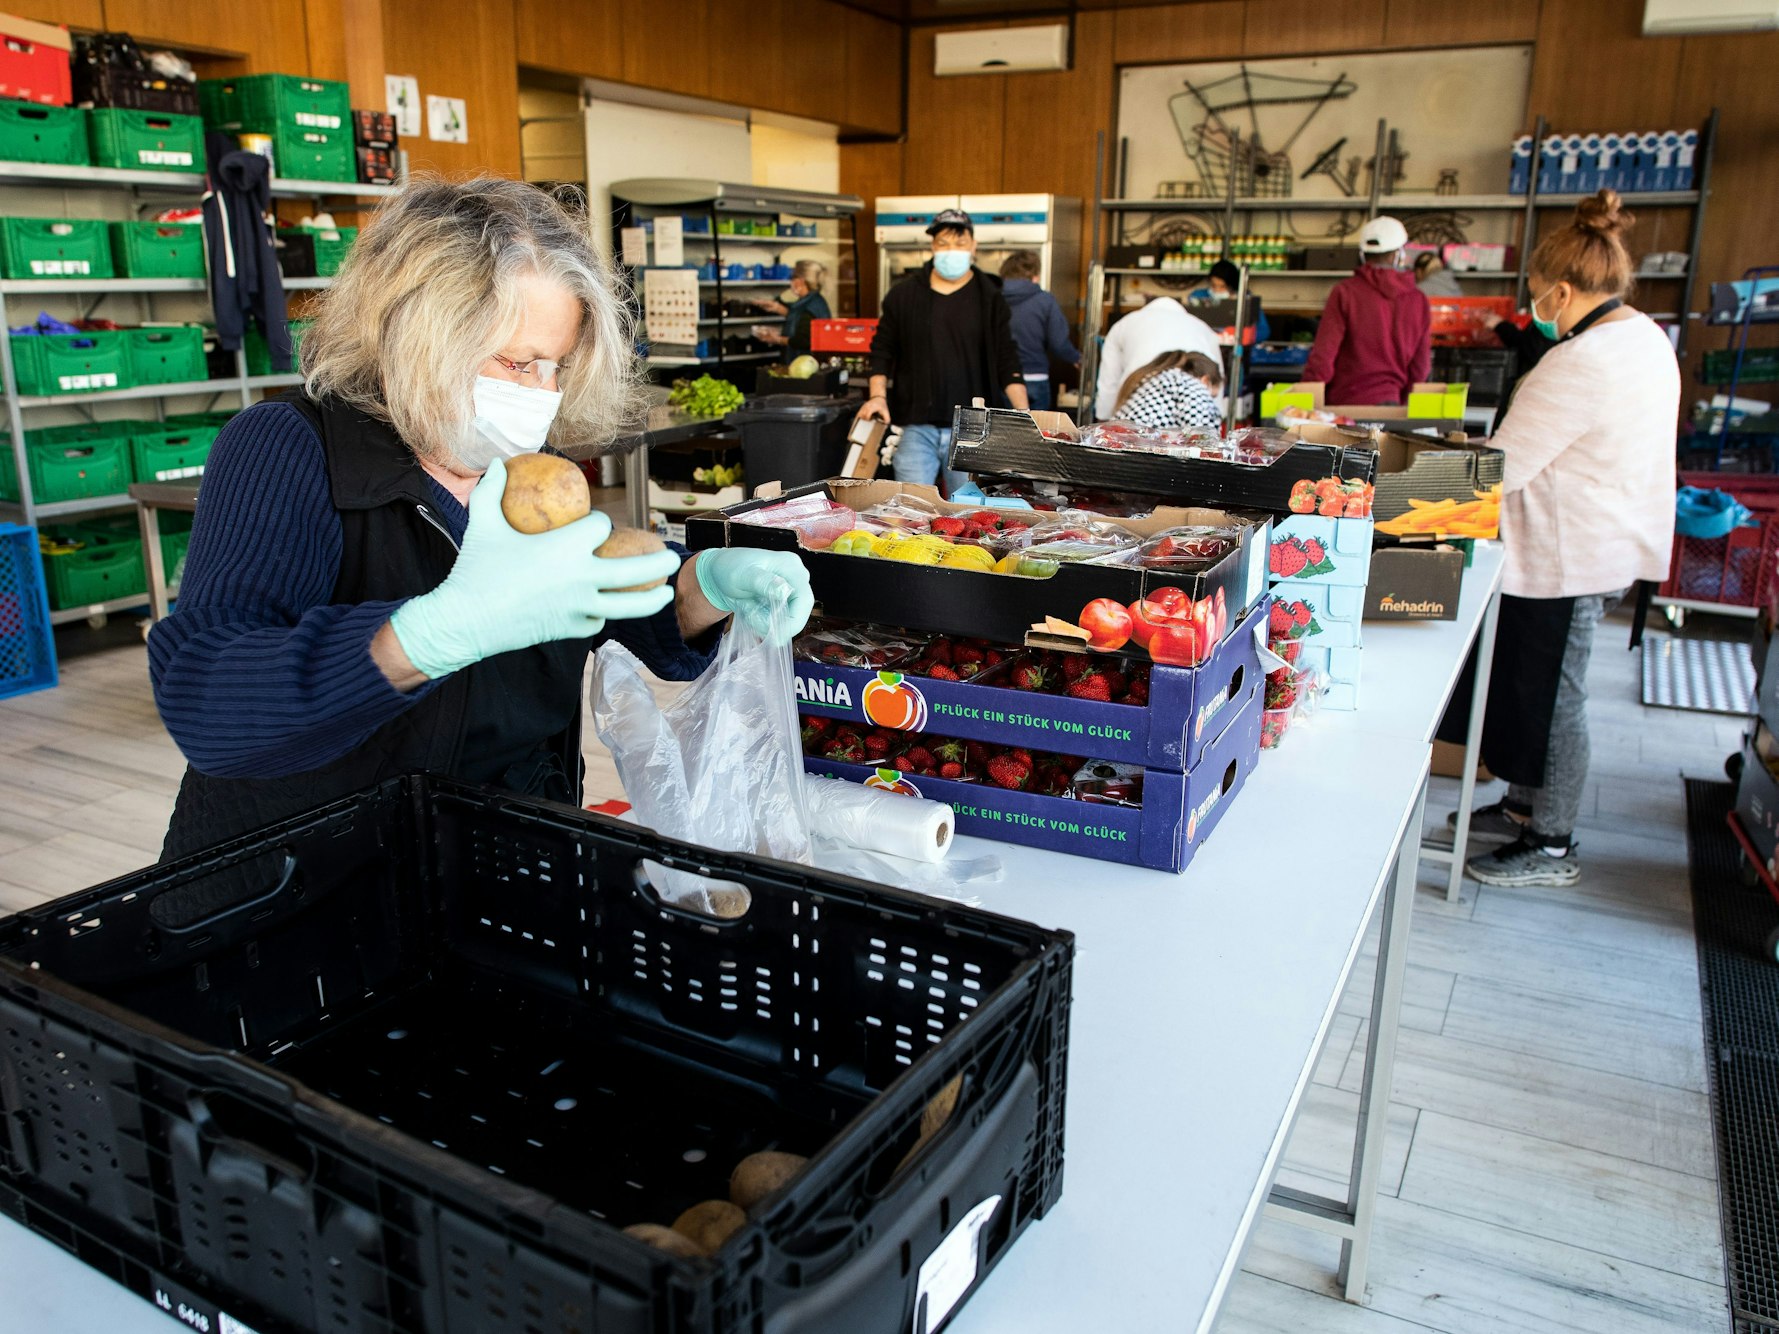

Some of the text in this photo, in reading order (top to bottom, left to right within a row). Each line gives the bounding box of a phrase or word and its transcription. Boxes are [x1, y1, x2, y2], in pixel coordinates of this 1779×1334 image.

[1380, 600, 1443, 613] mehadrin
[934, 703, 1131, 741] PFLÜCK EIN STÜCK VOM GLÜCK
[952, 801, 1127, 842] ÜCK EIN STÜCK VOM GLÜCK
